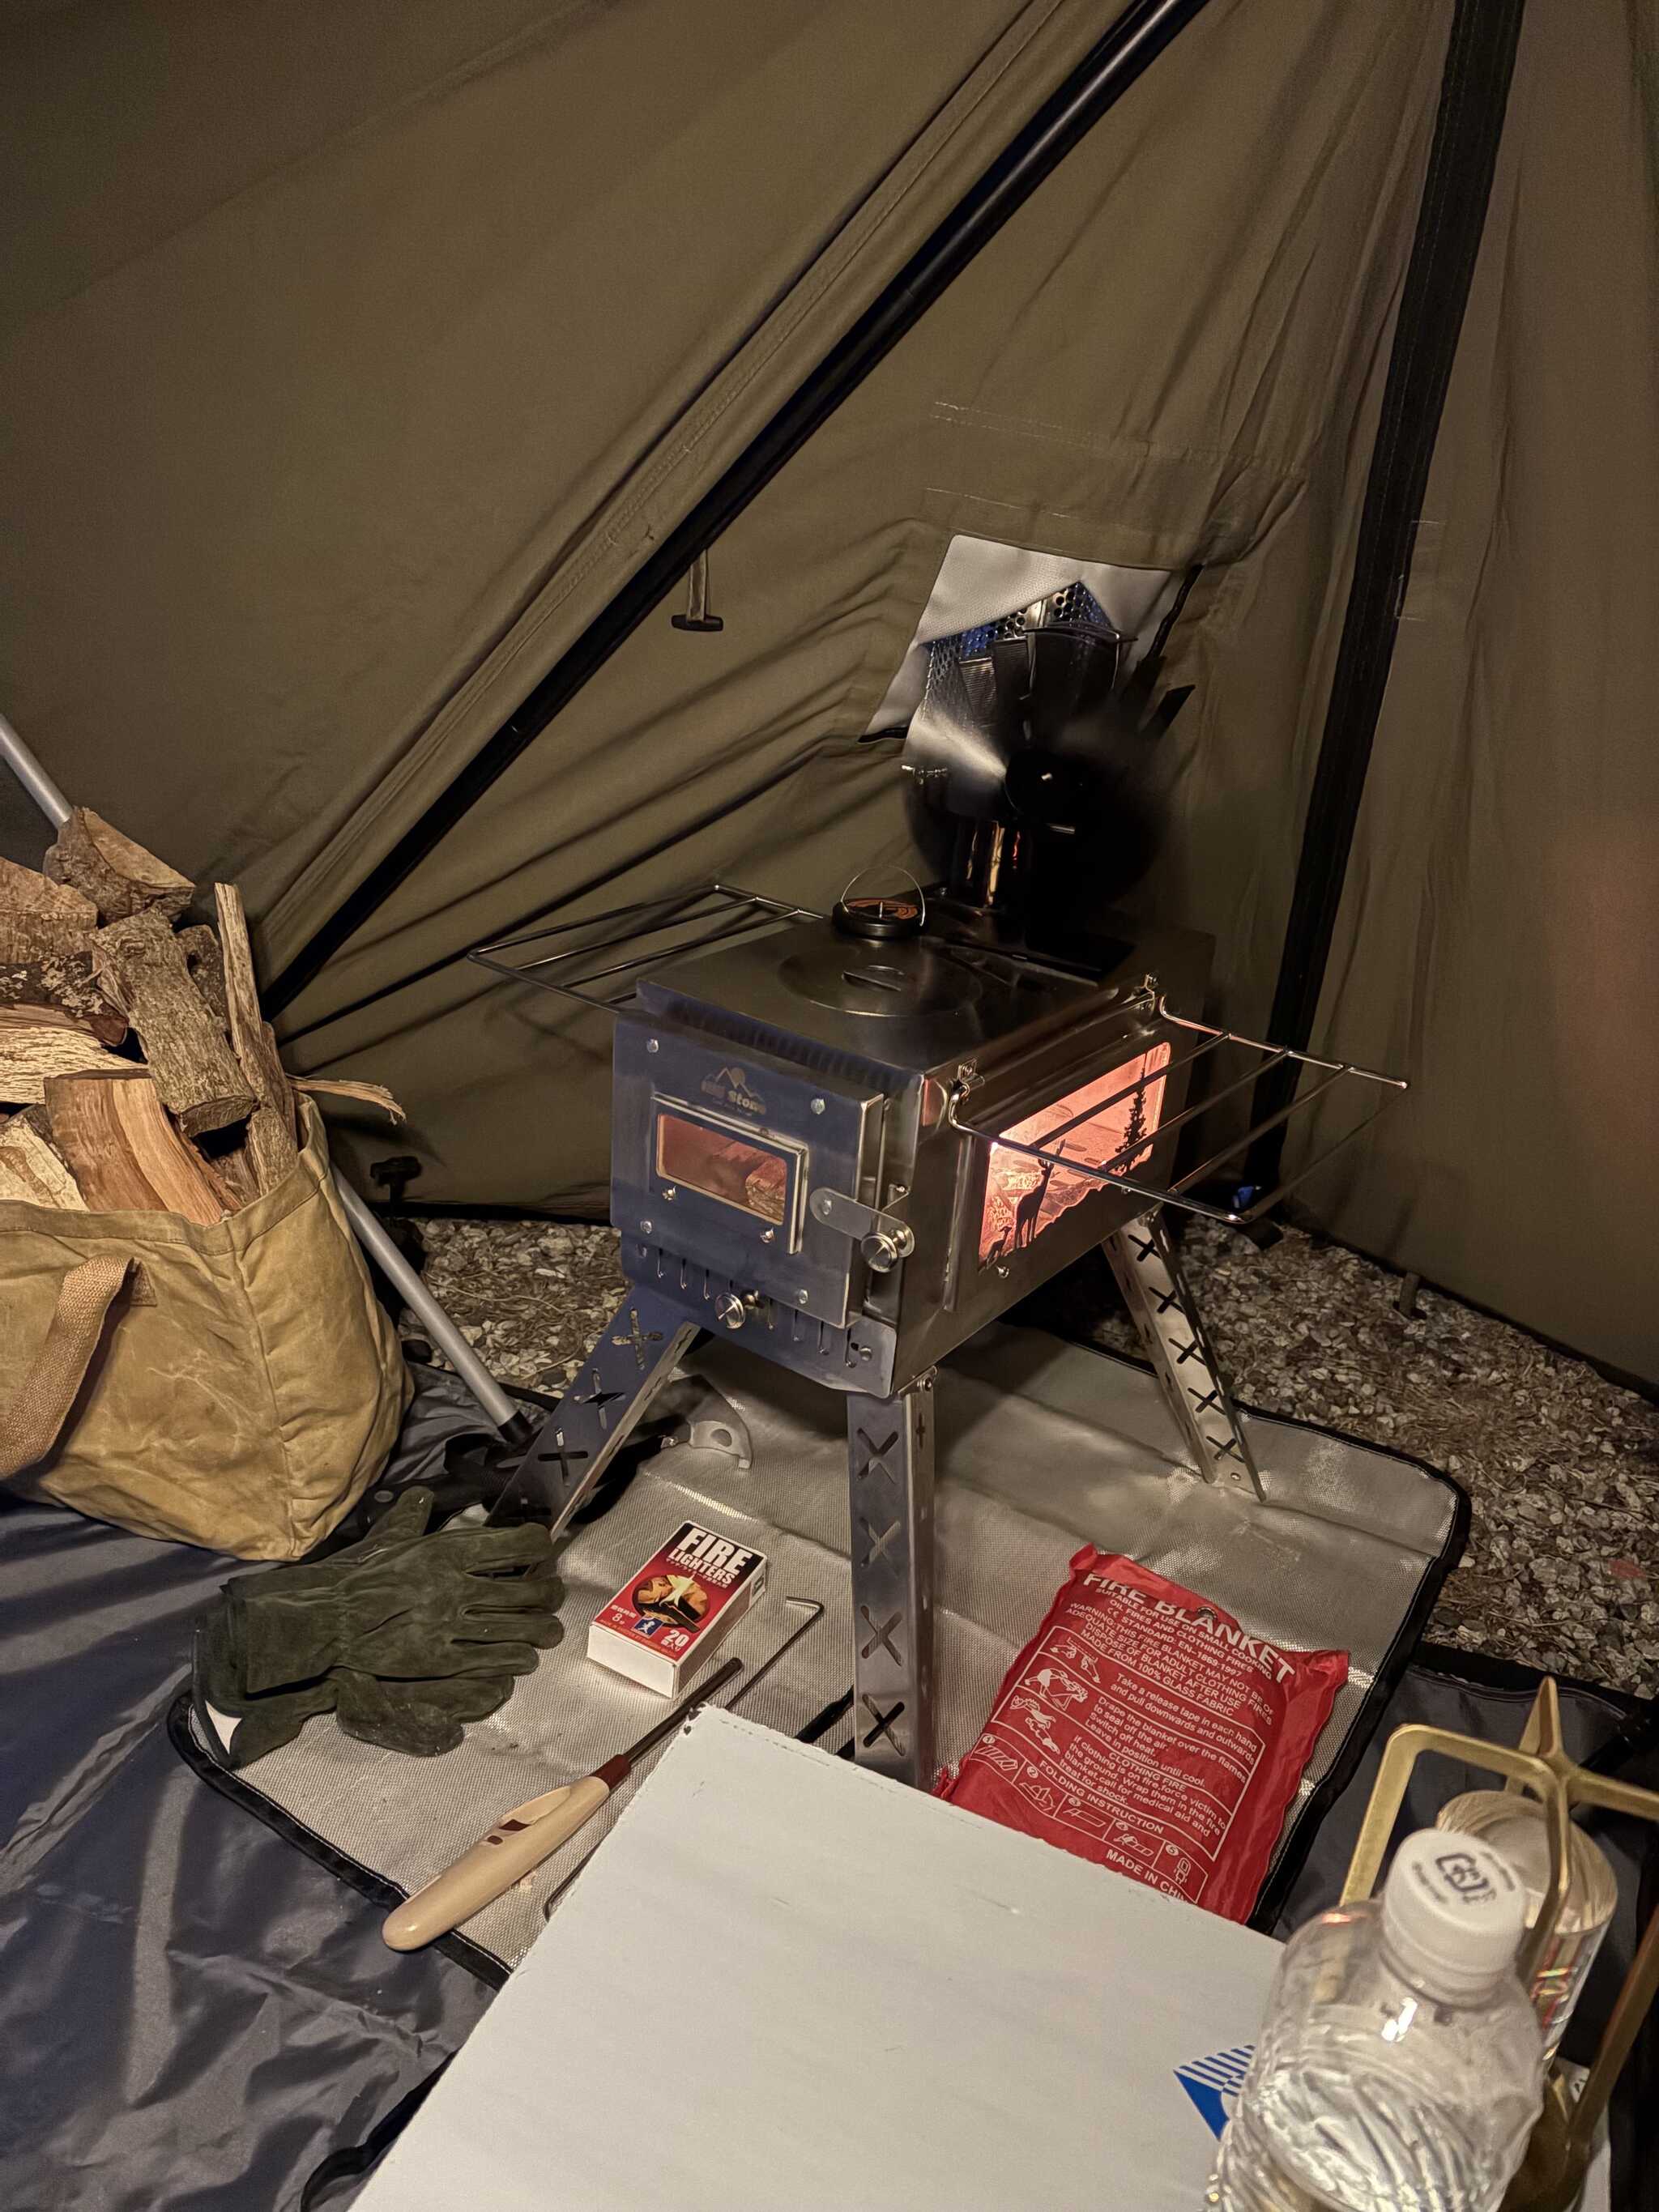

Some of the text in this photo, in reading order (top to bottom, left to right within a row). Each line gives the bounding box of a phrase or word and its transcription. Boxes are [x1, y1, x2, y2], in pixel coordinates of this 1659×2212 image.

[667, 1548, 736, 1584] LIGHTERS
[676, 1528, 753, 1575] FIRE
[664, 1629, 689, 1647] 20
[1083, 1573, 1296, 1683] FIRE BLANKET
[1095, 1588, 1272, 1680] SUITABLE FOR USE ON SMALL COOKING
[1110, 1599, 1254, 1673] OIL FIRES AND CLOTHING FIRES
[1065, 1609, 1273, 1725] ADEQUATE SIZE FOR ADULT CLOTHING FIRES
[1081, 1629, 1235, 1716] MADE FROM 100% GLASS FABRIC
[1085, 1622, 1242, 1710] DISPOSE OF BLANKET AFTER USE
[1137, 1633, 1161, 1647] FIRE
[1161, 1644, 1205, 1672] BLANKET
[1205, 1667, 1230, 1681] MAY
[1230, 1678, 1252, 1693] NOT
[1252, 1691, 1264, 1703] BE
[1089, 1711, 1156, 1757] Switch off heat.
[1094, 1703, 1103, 1715] to
[1103, 1711, 1124, 1727] seal
[1124, 1724, 1138, 1733] off
[1137, 1731, 1153, 1744] the
[1098, 1696, 1247, 1784] Drape the blanket over the flames
[1111, 1683, 1255, 1766] and pull downwards and outwards
[1116, 1673, 1257, 1753] Take a release tape in each hand
[1060, 1758, 1128, 1805] treat for shock.
[1069, 1742, 1084, 1758] the
[1123, 1777, 1149, 1794] Wrap
[1151, 1790, 1176, 1805] them
[1178, 1801, 1188, 1811] in
[1188, 1807, 1205, 1821] the
[1205, 1818, 1221, 1835] fire
[1081, 1741, 1116, 1771] clothing
[1117, 1765, 1126, 1774] is
[1127, 1771, 1141, 1782] on
[1190, 1798, 1218, 1820] victim
[1218, 1818, 1226, 1830] to
[1085, 1719, 1205, 1787] Leave in position until cool.
[1109, 1752, 1186, 1792] CLOTHING FIRE
[1039, 1760, 1164, 1835] FOLDING INSTRUCTION
[1118, 1785, 1133, 1796] for
[1133, 1792, 1174, 1813] medical
[1175, 1811, 1192, 1822] aid
[1192, 1820, 1211, 1837] and
[1106, 1849, 1144, 1876] MADE
[1144, 1870, 1158, 1885] IN
